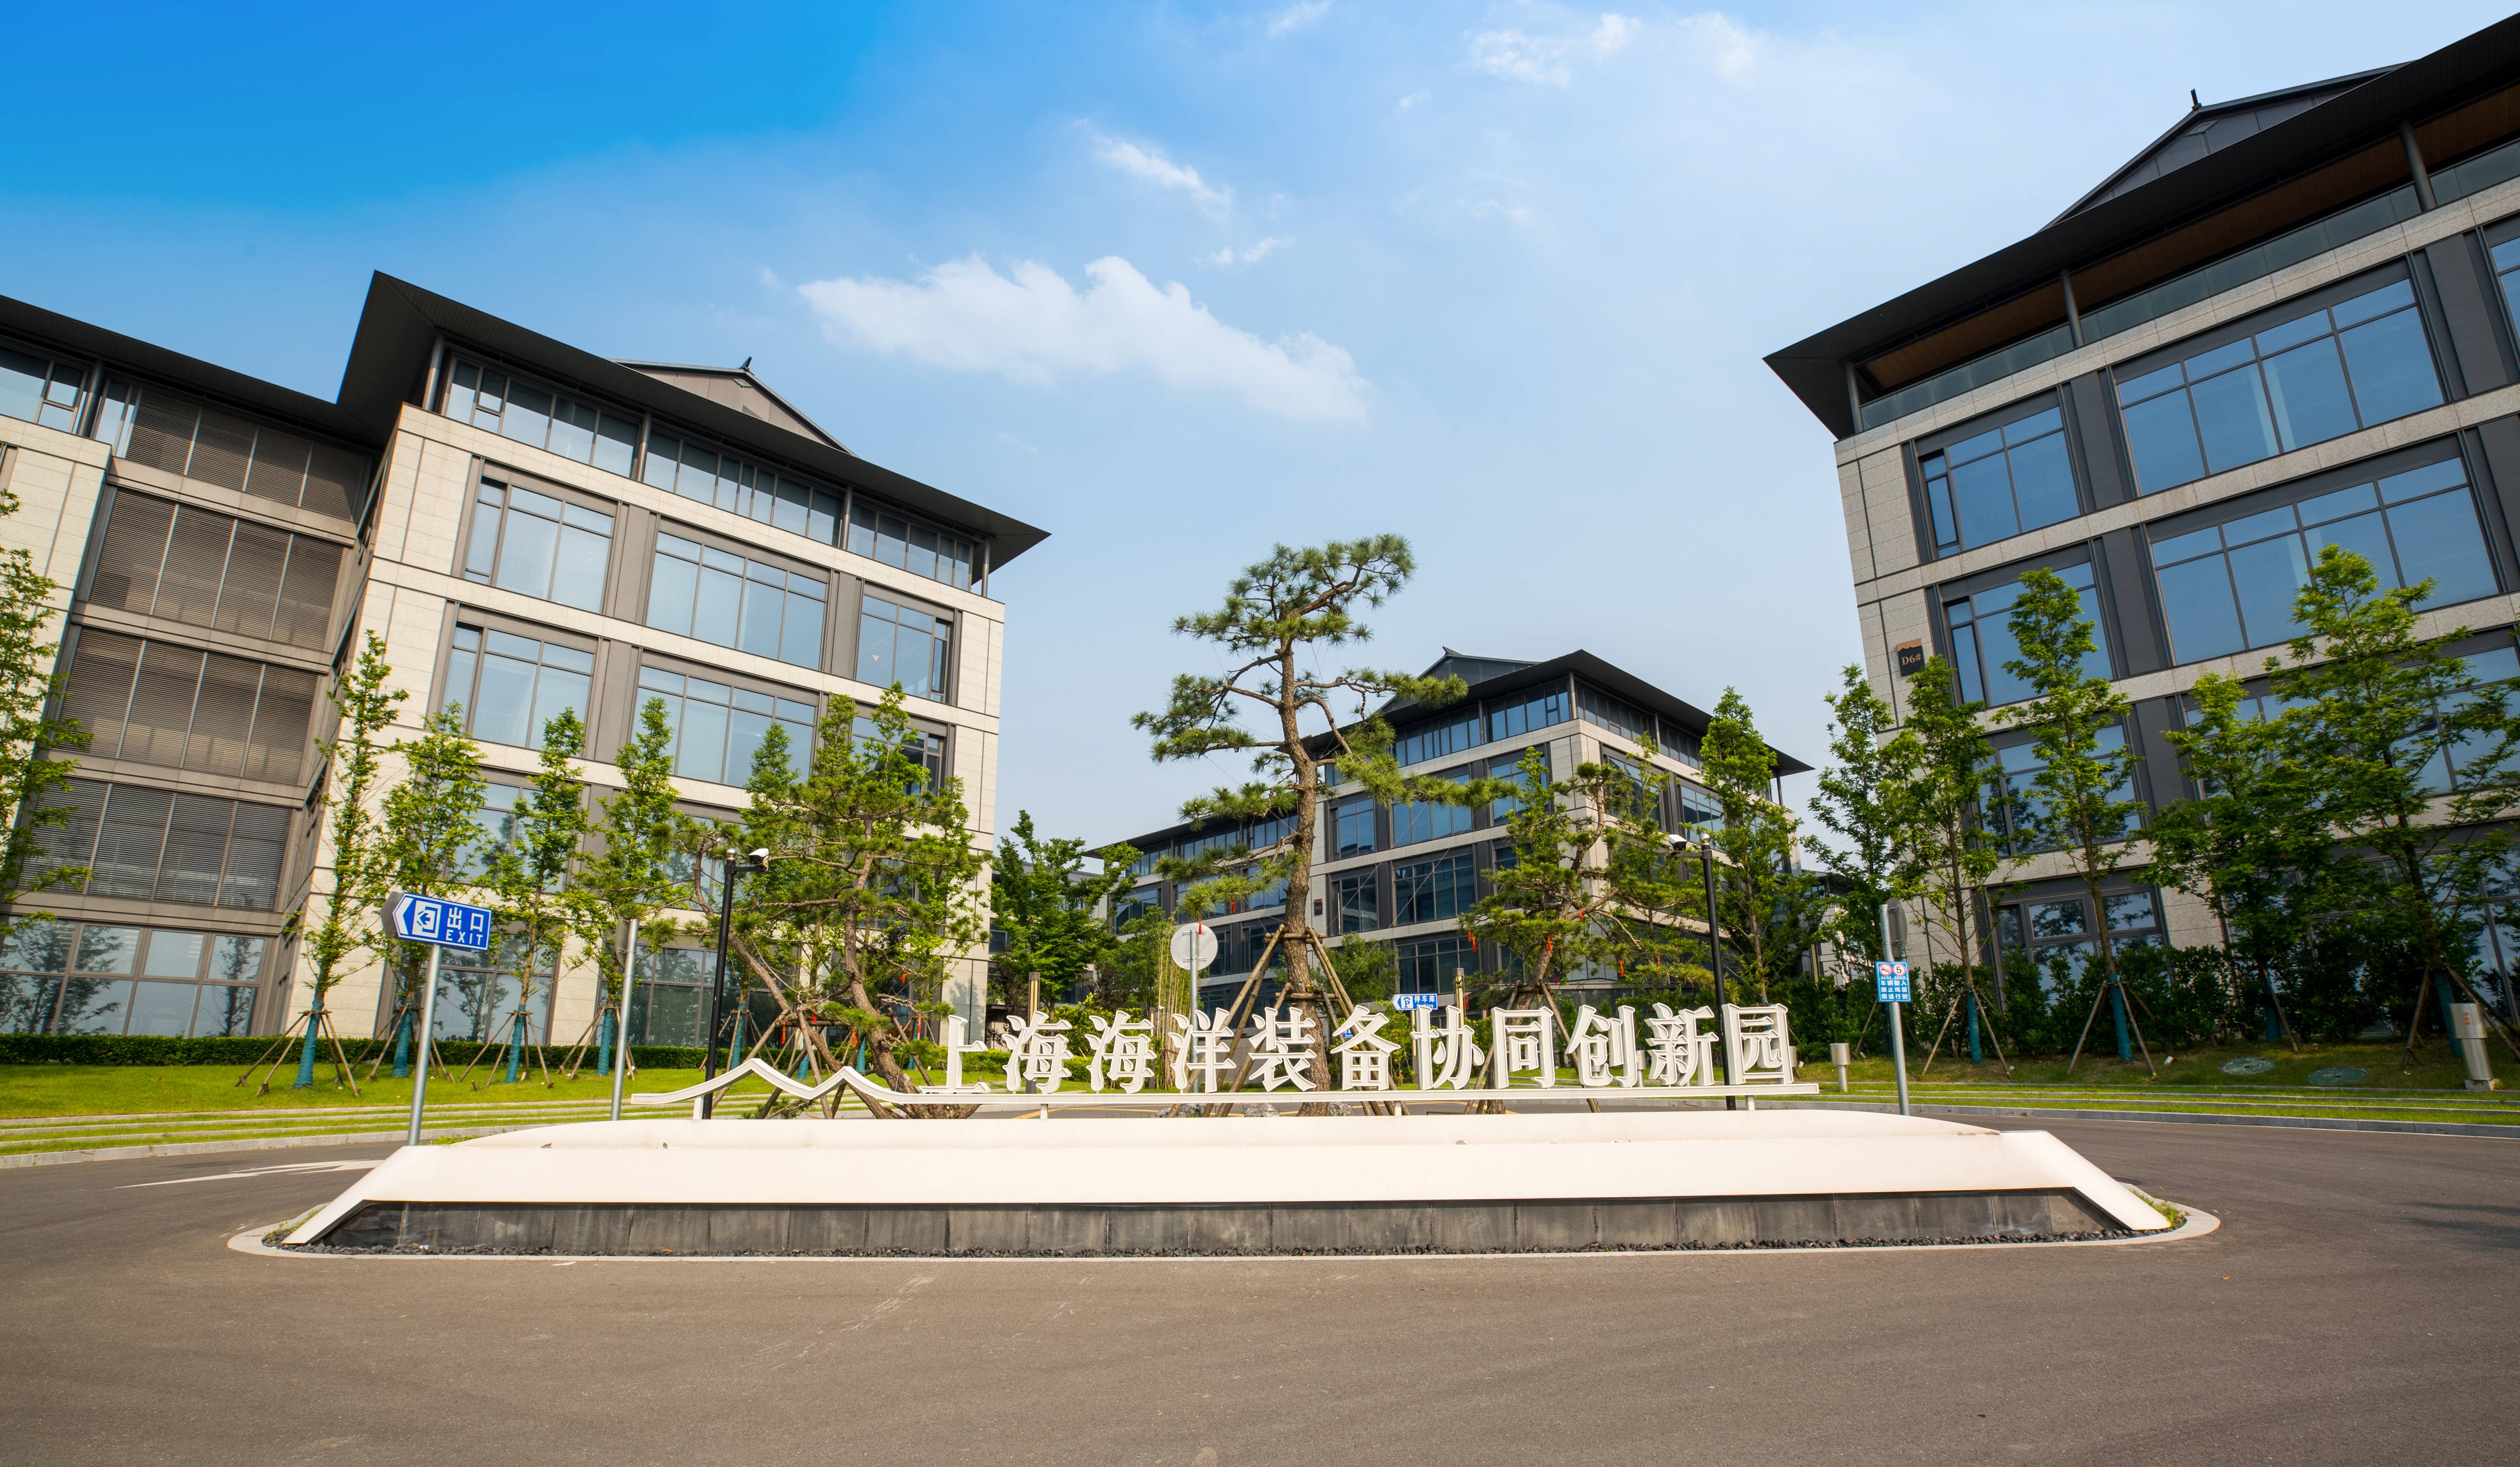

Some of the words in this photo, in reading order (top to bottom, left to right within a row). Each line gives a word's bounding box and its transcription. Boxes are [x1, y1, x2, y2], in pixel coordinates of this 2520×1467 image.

[1902, 653, 1921, 665] D6#
[447, 907, 484, 932] 出口
[446, 929, 483, 945] EXIT
[919, 1002, 1793, 1094] 上海海洋装备协同创新园
